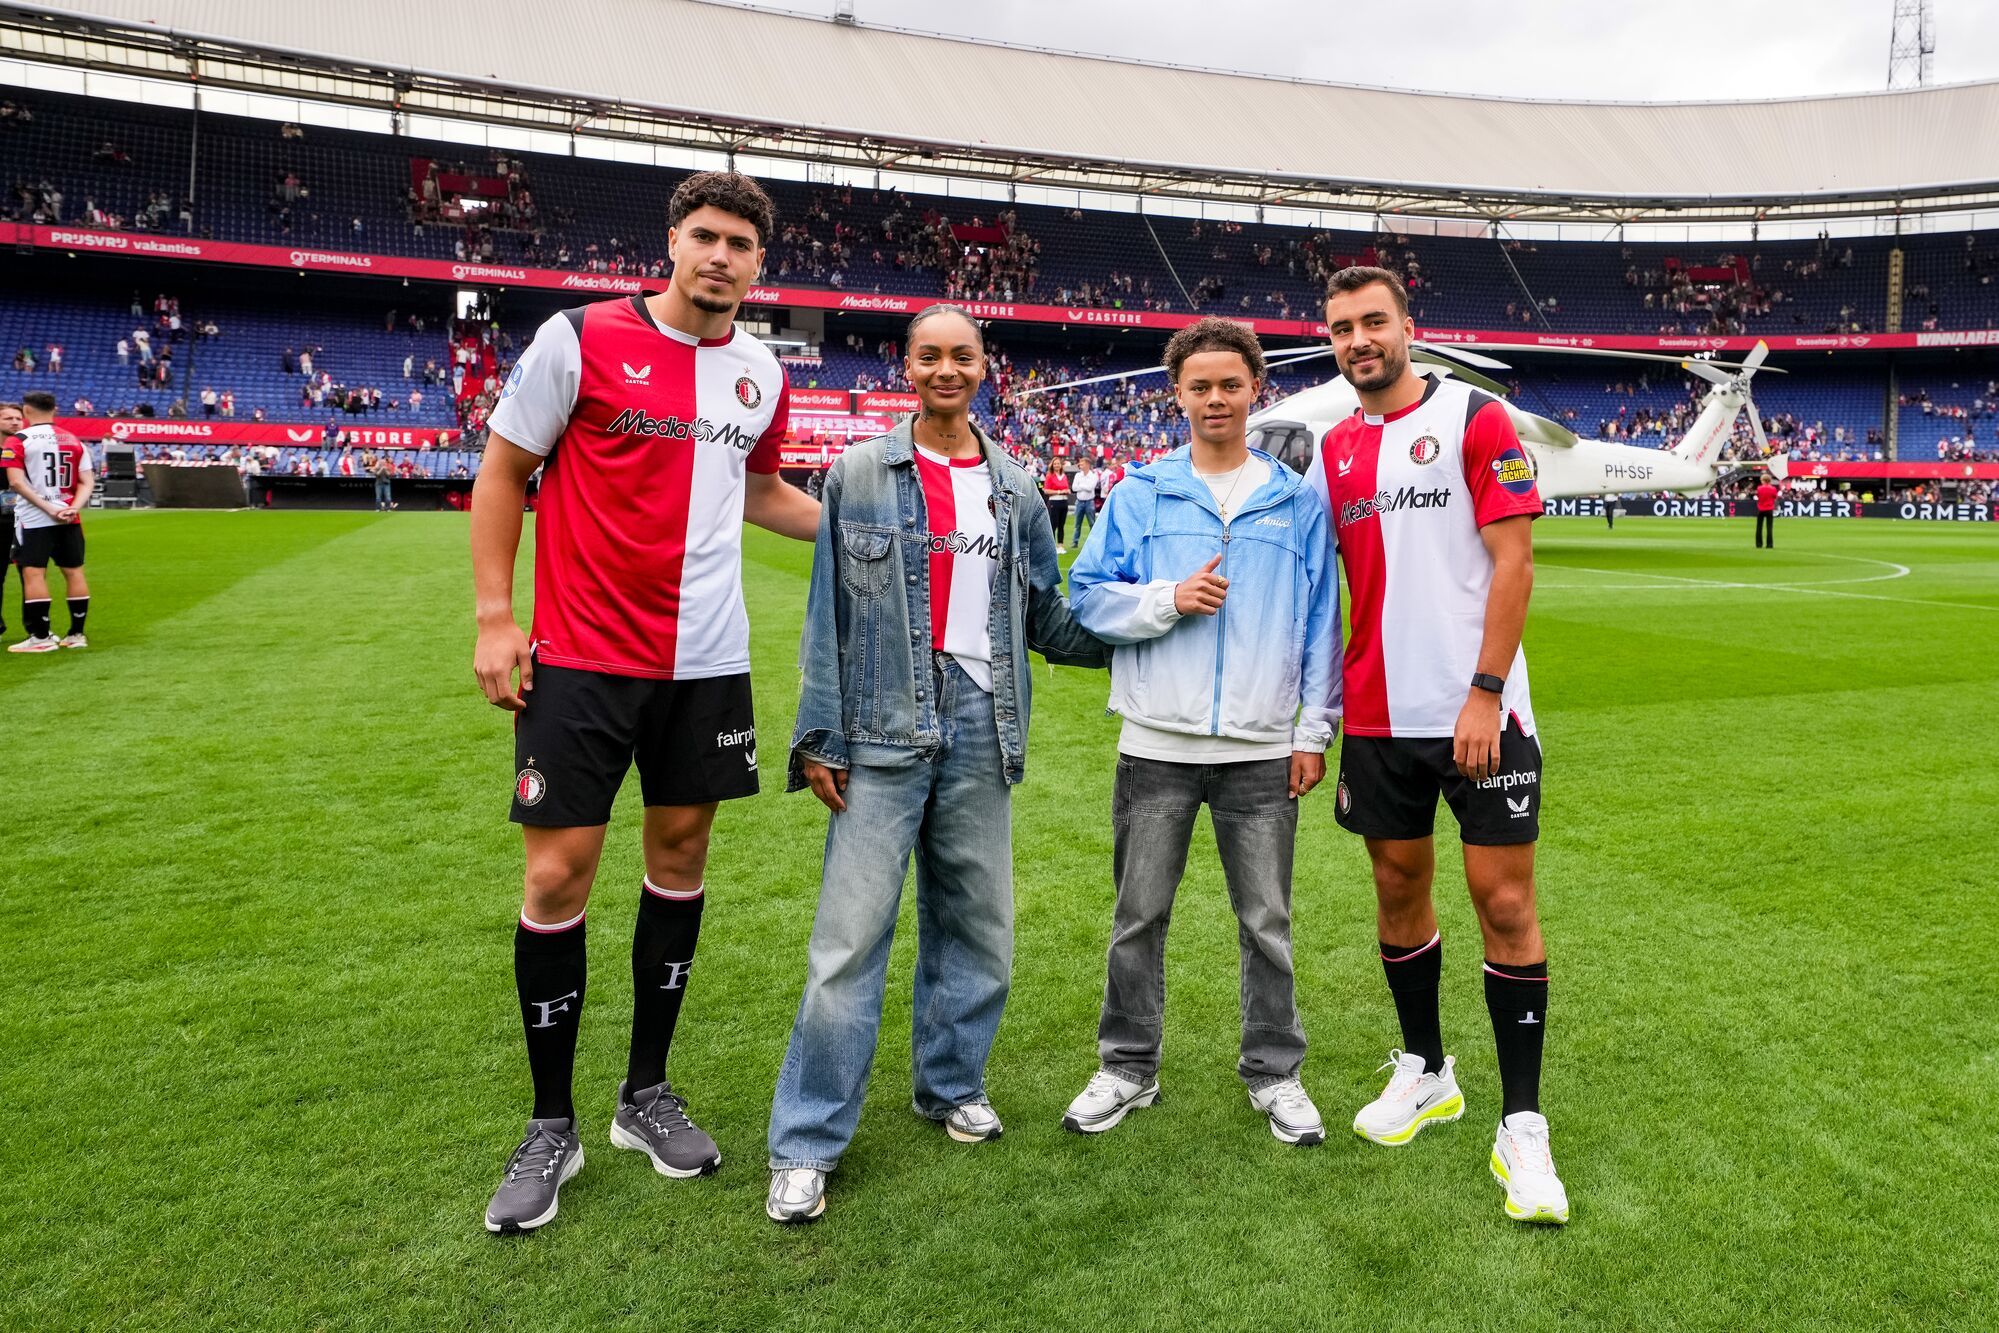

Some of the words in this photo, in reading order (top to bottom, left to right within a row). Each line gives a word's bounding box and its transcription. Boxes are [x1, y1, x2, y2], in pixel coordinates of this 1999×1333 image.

[133, 241, 201, 255] vakanties
[1087, 311, 1142, 324] CASTORE
[1916, 331, 1987, 347] WINNAAR
[607, 407, 690, 440] Media
[43, 451, 72, 488] 35
[1605, 464, 1653, 480] PH-SSF
[1340, 498, 1374, 528] Media
[1391, 486, 1451, 512] Markt
[1653, 500, 1725, 517] ORMER
[1900, 503, 1988, 521] ORMER
[531, 989, 578, 1029] F
